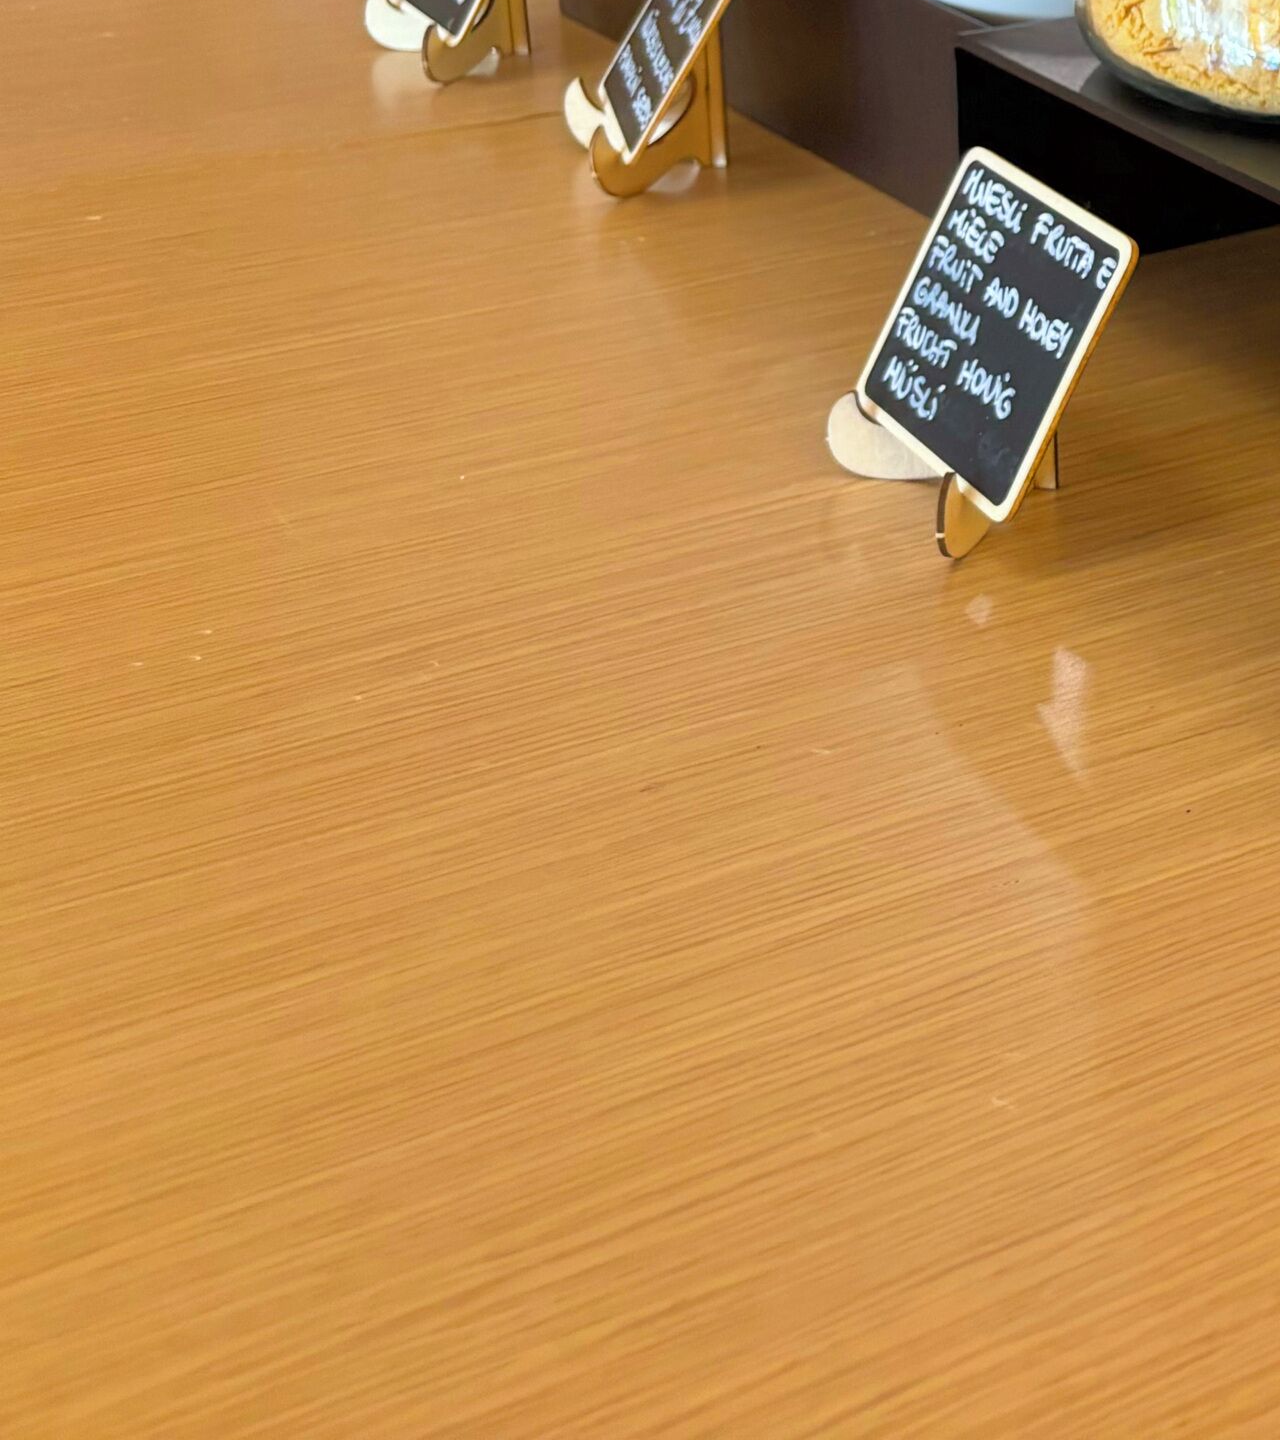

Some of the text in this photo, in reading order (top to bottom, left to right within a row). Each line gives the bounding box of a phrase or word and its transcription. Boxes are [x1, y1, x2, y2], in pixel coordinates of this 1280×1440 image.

[1030, 213, 1094, 279] FRUTTA
[1096, 257, 1117, 290] E
[896, 307, 957, 368] FRUCHT
[983, 277, 1019, 318] AND
[1018, 299, 1073, 359] HONEY
